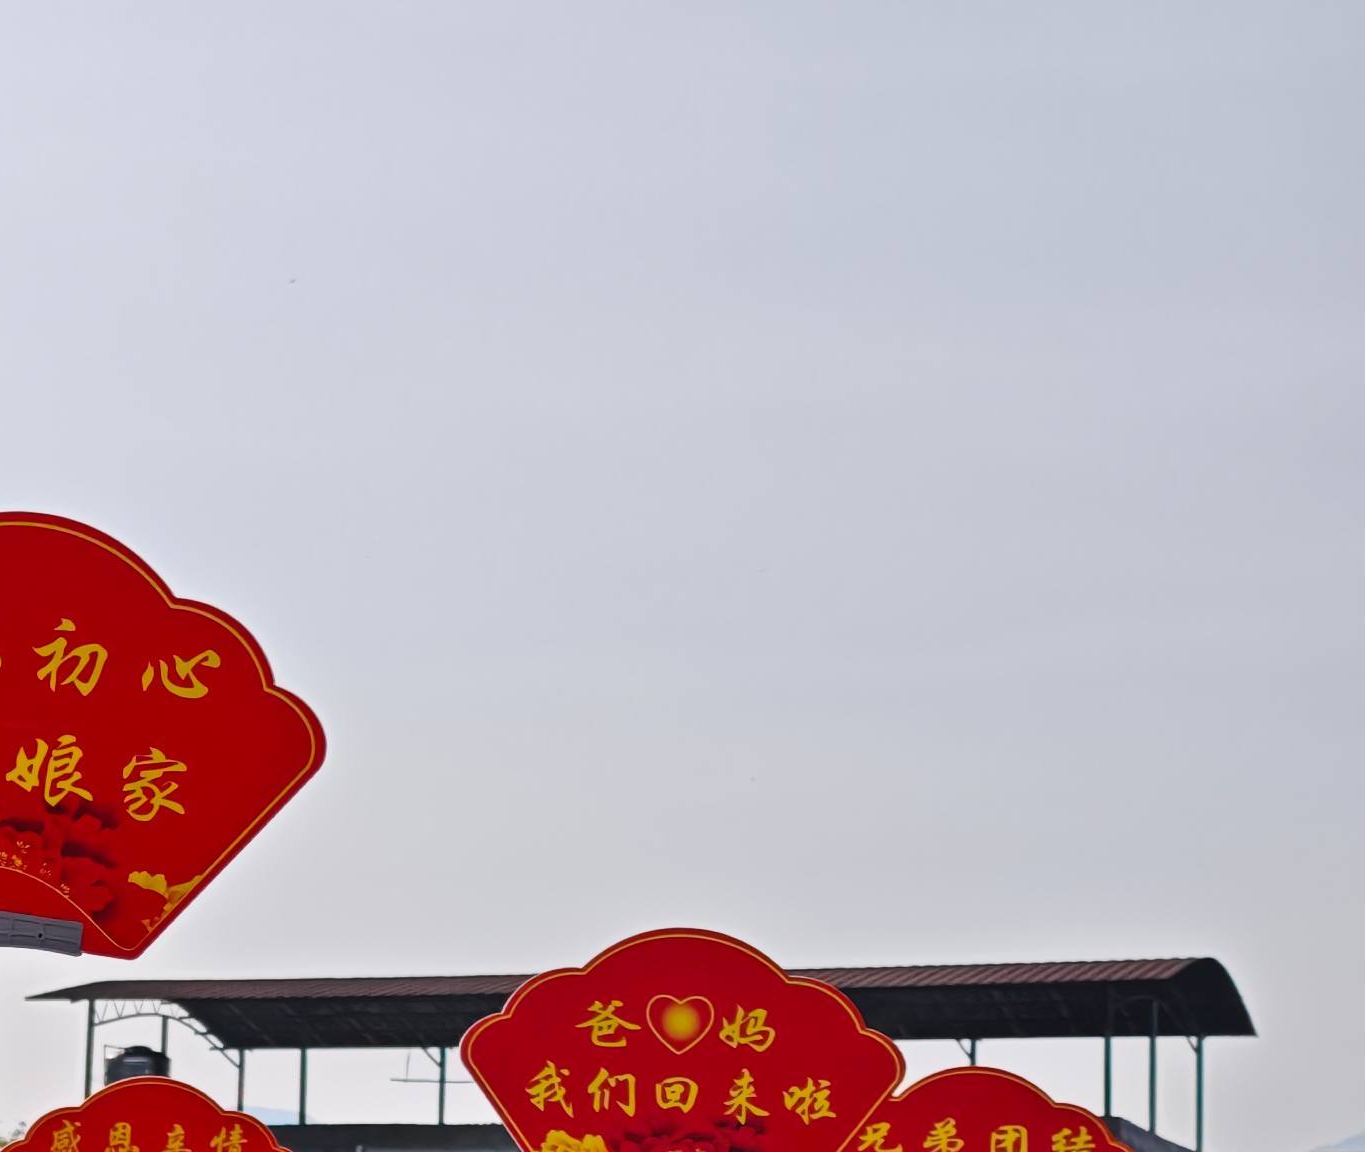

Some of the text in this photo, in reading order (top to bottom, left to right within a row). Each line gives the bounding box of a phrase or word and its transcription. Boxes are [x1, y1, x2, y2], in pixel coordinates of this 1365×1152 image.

[525, 1061, 837, 1125] 我们回来啦
